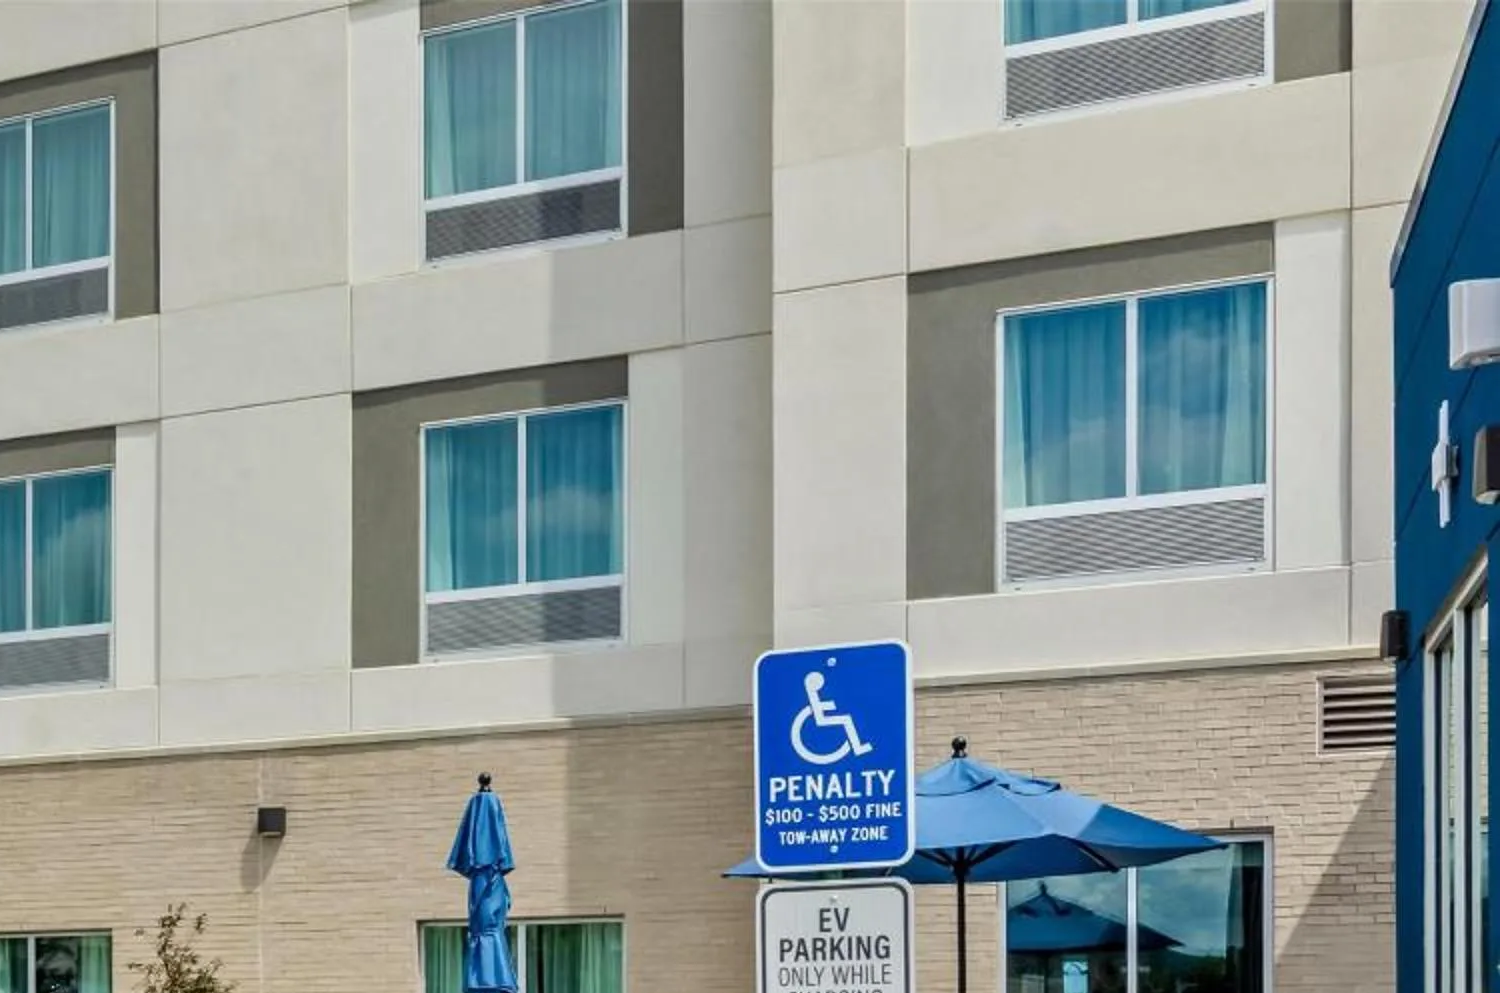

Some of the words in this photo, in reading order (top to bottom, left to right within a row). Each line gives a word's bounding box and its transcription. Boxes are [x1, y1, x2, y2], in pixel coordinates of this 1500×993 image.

[769, 769, 895, 802] PENALTY
[765, 807, 802, 825] $100
[819, 805, 860, 822] $500
[865, 802, 902, 818] FINE
[779, 828, 847, 845] TOW-AWAY
[851, 826, 888, 841] ZONE
[819, 907, 850, 932] EV
[779, 935, 891, 962] PARKING
[778, 966, 827, 987] ONLY
[831, 963, 892, 985] WHILE
